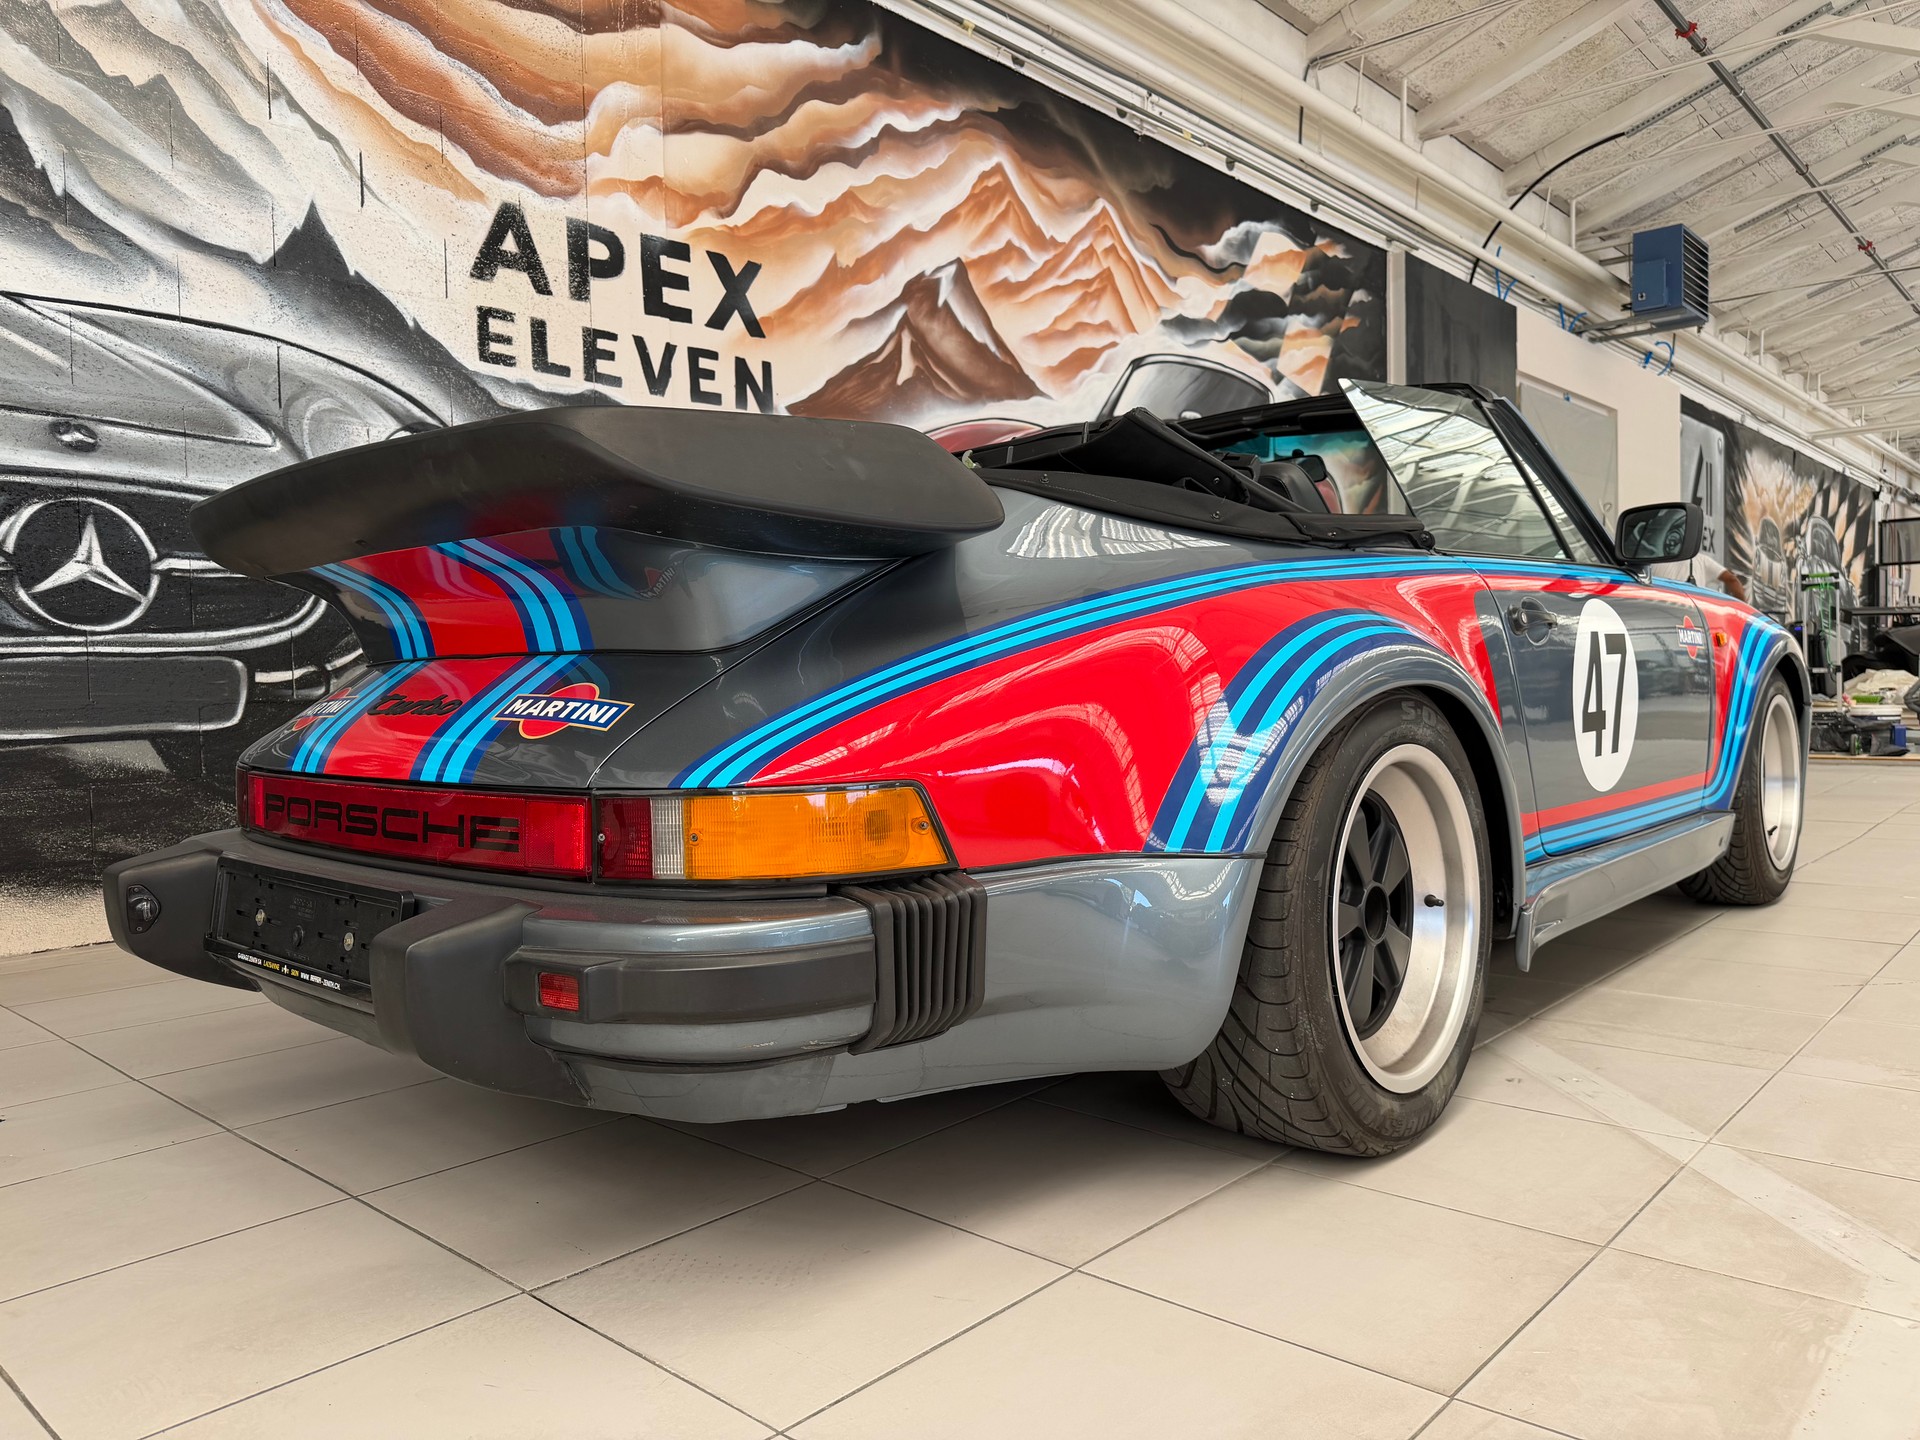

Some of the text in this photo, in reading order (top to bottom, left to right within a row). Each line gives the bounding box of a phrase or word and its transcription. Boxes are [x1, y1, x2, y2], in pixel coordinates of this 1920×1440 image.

[469, 201, 766, 338] APEX
[476, 305, 774, 414] ELEVEN
[1702, 526, 1715, 554] EX
[1678, 628, 1703, 645] MARTINI
[503, 699, 619, 724] MARTINI
[1582, 631, 1627, 757] 47
[265, 794, 520, 853] PORSCHE
